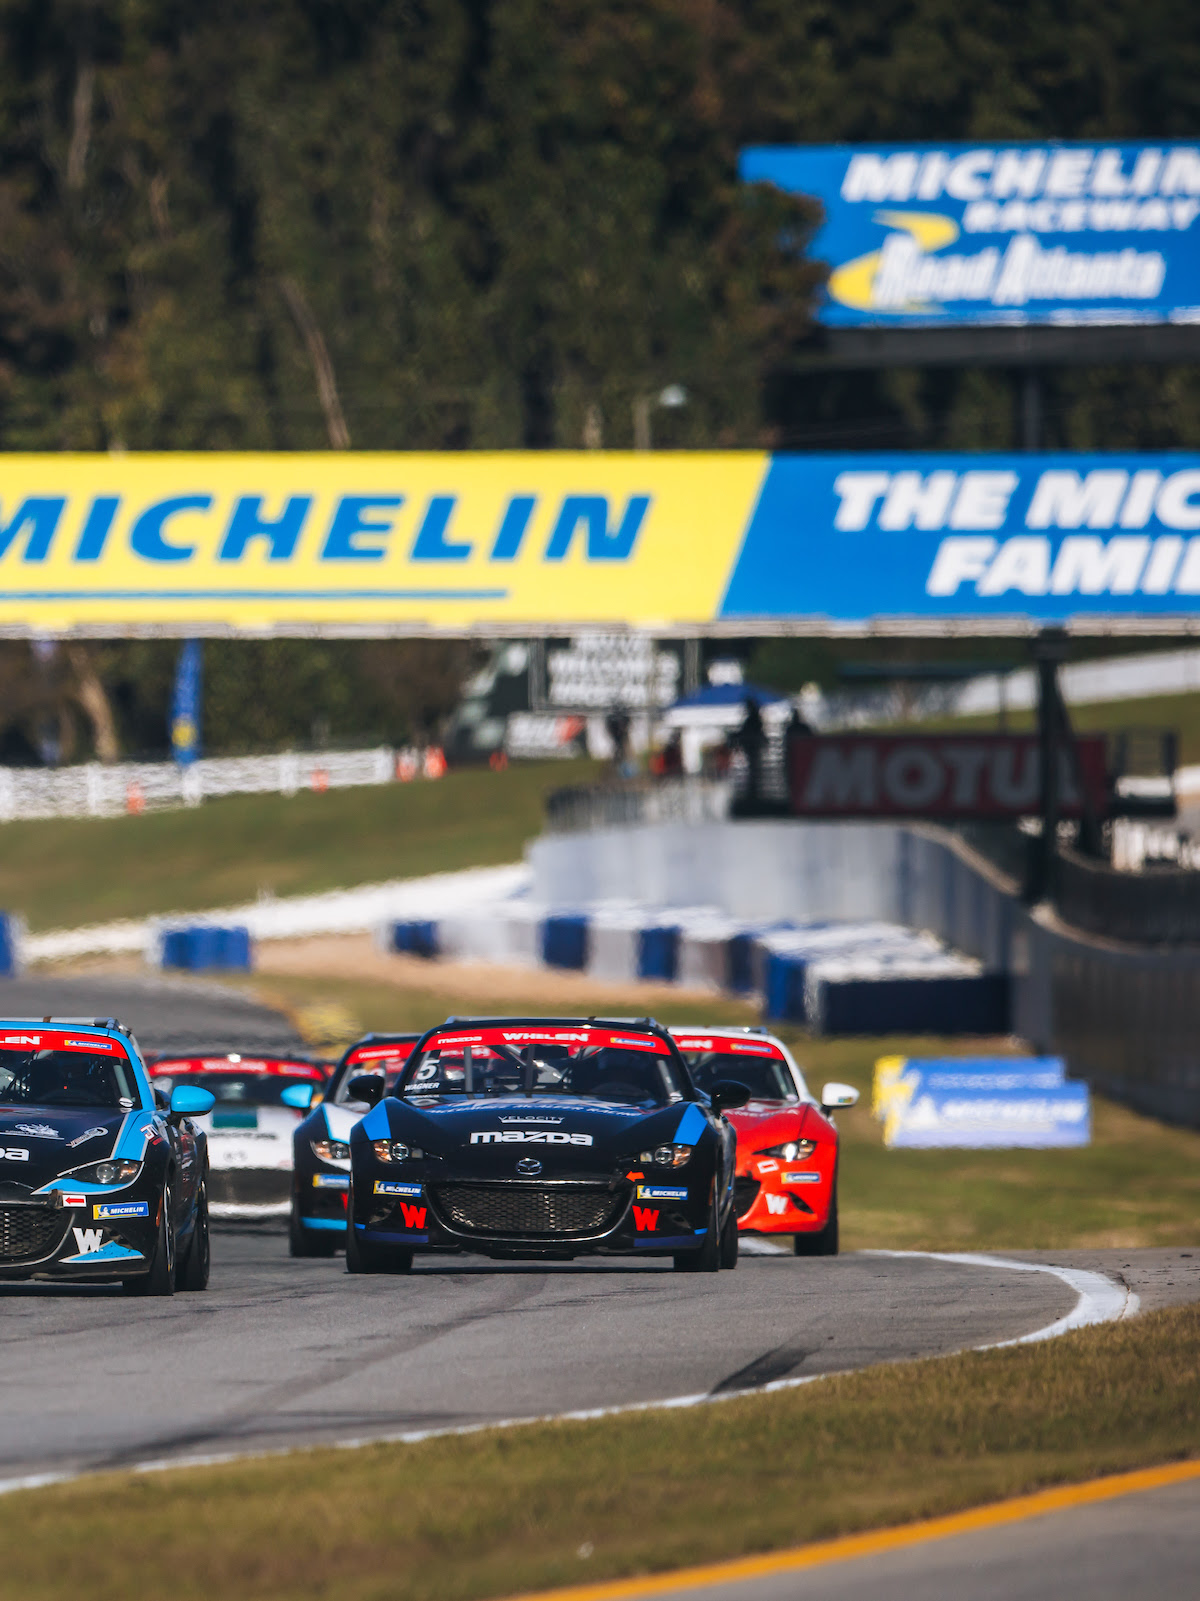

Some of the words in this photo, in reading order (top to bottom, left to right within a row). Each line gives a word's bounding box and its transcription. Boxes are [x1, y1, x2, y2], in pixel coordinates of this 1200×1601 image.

[834, 469, 1019, 532] THE
[502, 1033, 589, 1042] WHELEN
[416, 1059, 440, 1081] 5
[404, 1082, 440, 1092] WAGNER
[386, 1186, 421, 1194] MICHELIN
[652, 1189, 688, 1197] MICHELIN
[110, 1206, 145, 1214] MICHELIN
[400, 1202, 428, 1229] W
[632, 1205, 660, 1231] W
[72, 1227, 103, 1254] W
